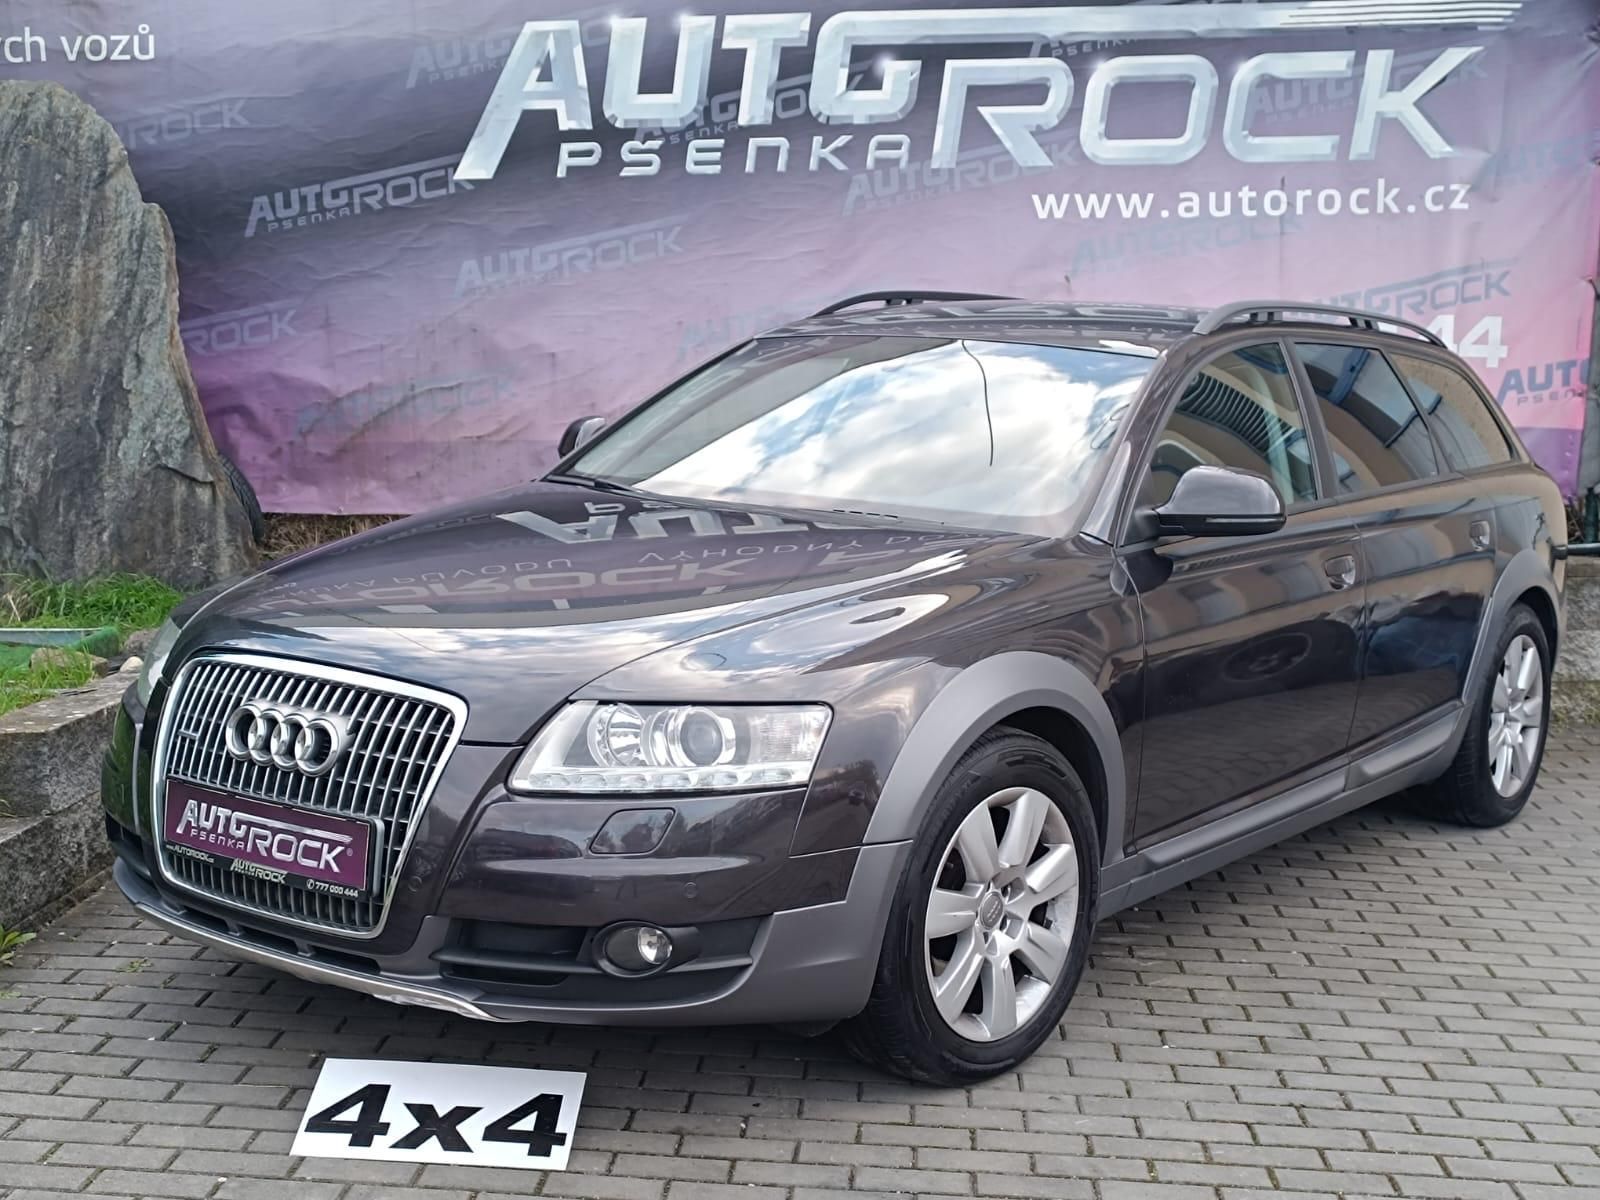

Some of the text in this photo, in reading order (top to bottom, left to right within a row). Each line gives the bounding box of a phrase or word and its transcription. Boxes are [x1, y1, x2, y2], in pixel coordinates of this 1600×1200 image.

[0, 23, 155, 63] ch vozů
[1032, 178, 1470, 219] www.autorock.cz
[315, 881, 329, 892] 777
[304, 1083, 567, 1157] 4x4
